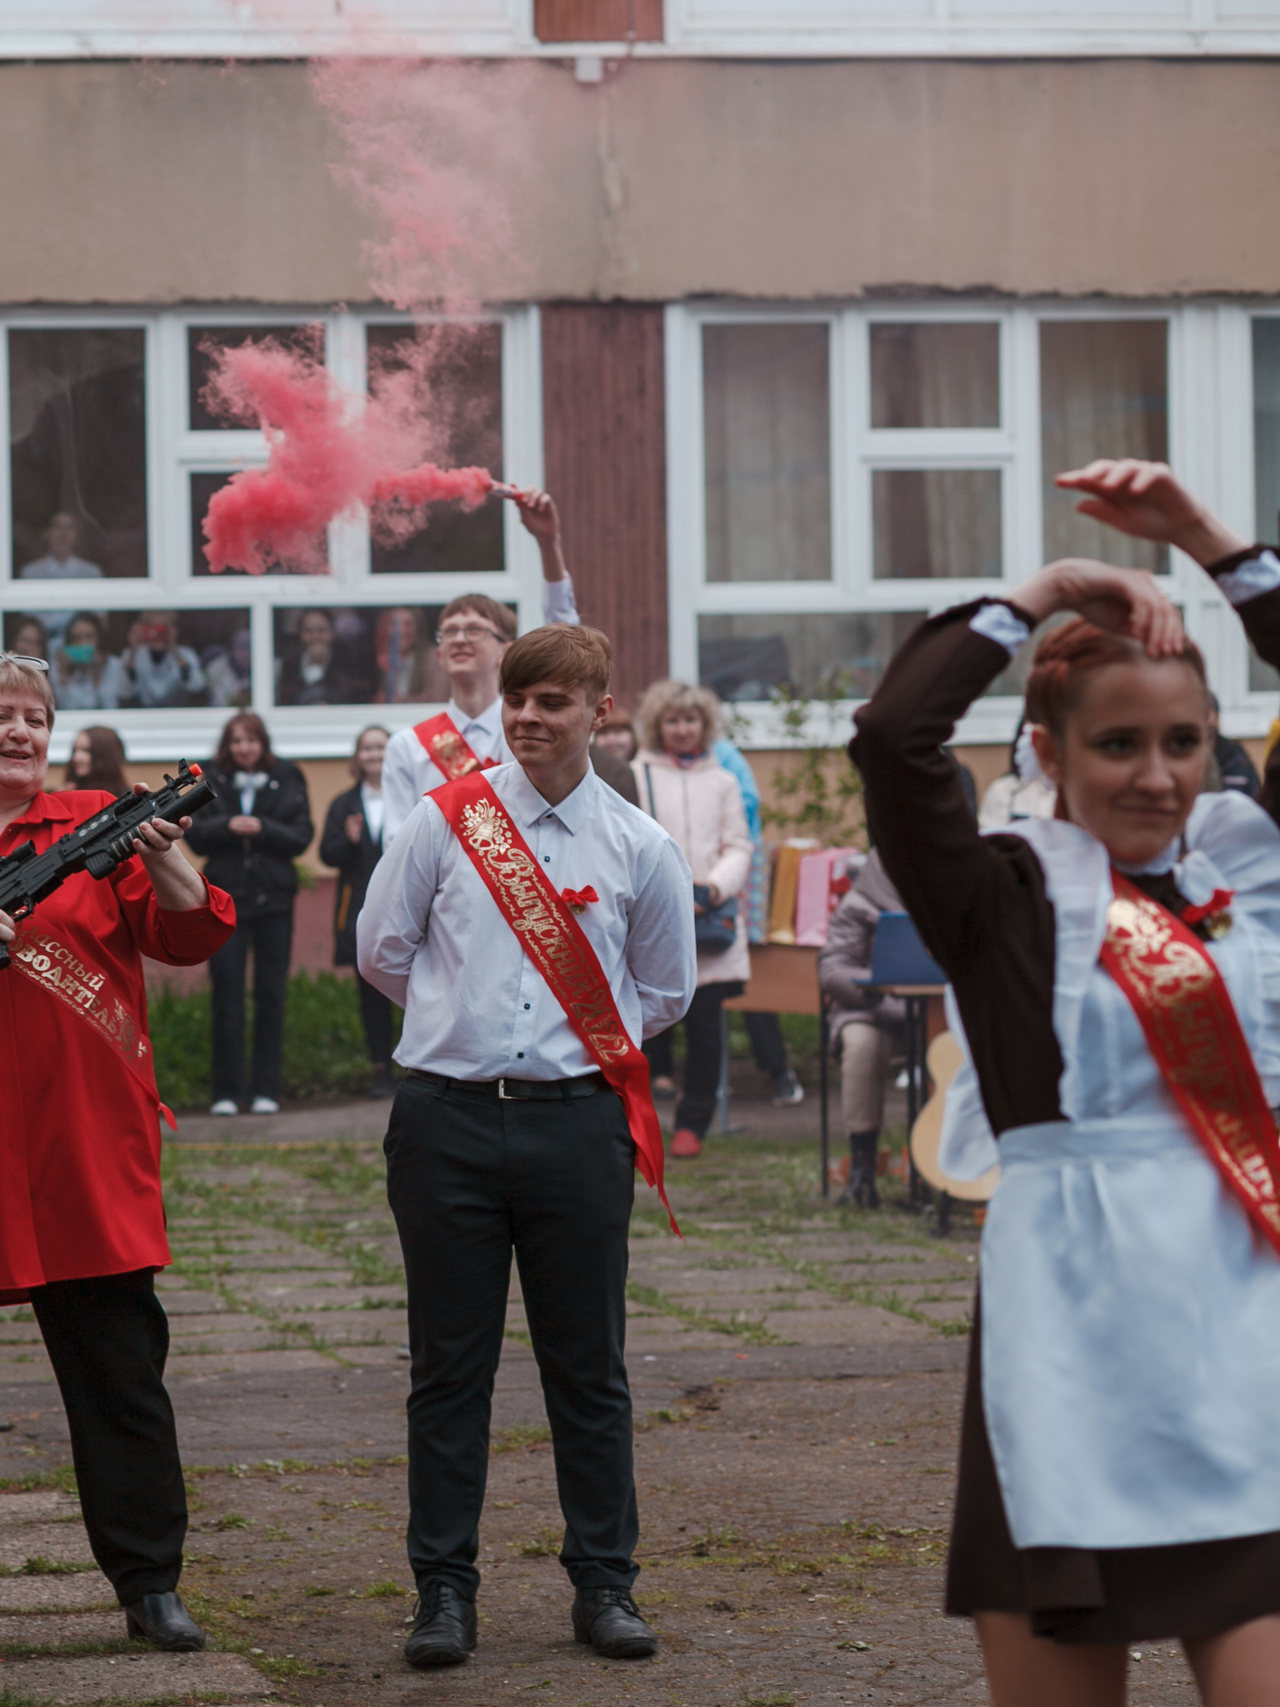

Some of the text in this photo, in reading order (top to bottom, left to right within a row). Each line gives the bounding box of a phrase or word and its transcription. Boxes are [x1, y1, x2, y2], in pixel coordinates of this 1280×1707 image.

[20, 926, 107, 992] лассный
[486, 847, 630, 1067] Выпускник 2022
